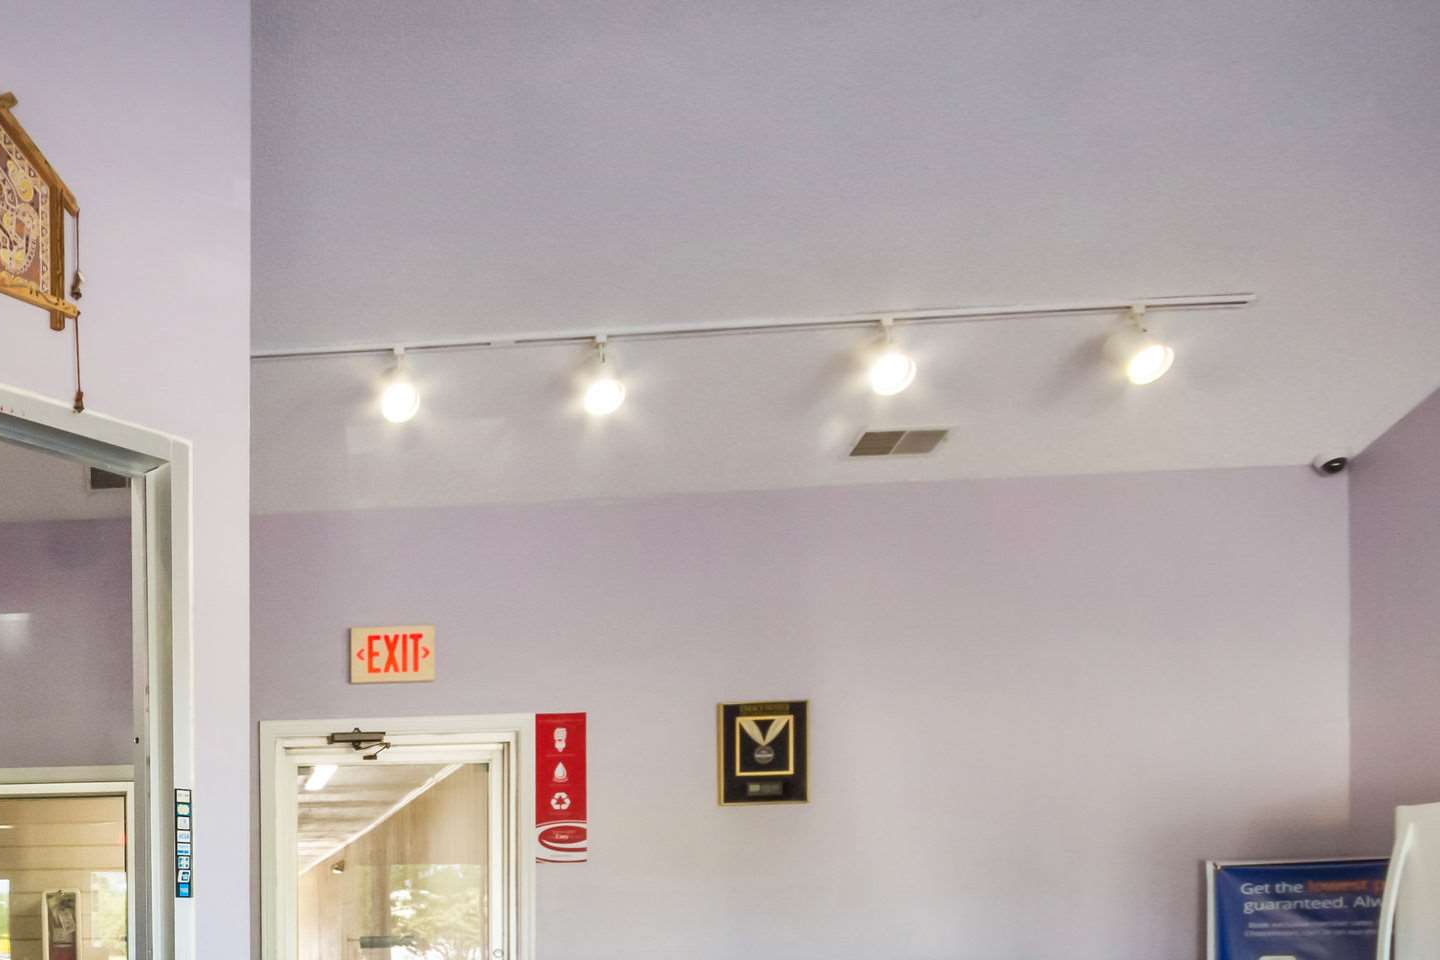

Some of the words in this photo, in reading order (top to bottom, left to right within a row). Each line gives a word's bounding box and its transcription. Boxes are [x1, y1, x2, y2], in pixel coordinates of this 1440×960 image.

[367, 633, 423, 674] EXIT
[1240, 882, 1271, 895] Get
[1275, 882, 1304, 894] the
[1243, 896, 1348, 915] guaranteed.
